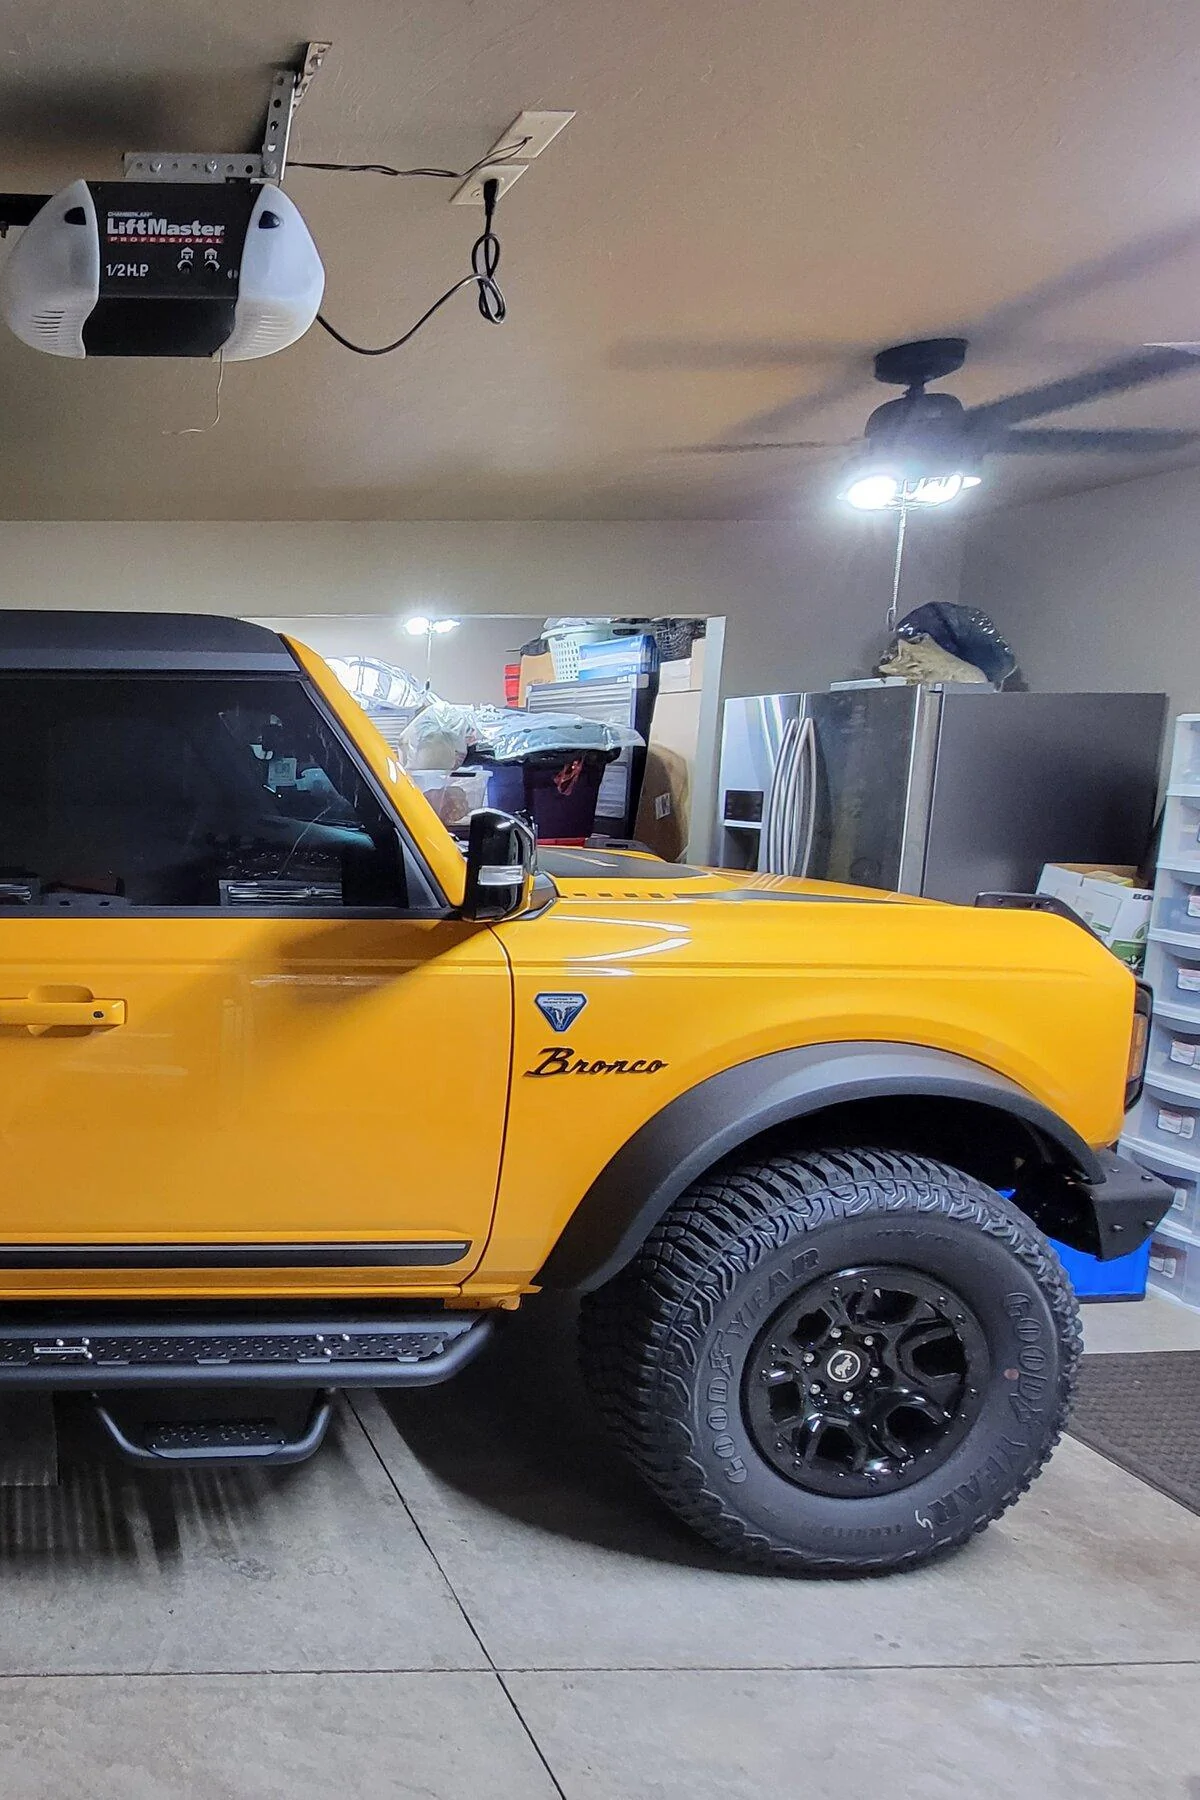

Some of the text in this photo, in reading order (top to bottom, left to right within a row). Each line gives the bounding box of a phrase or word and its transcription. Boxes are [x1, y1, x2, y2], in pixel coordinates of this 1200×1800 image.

[107, 218, 225, 236] LiftMaster
[110, 236, 222, 244] PROFESSIONAL
[523, 1047, 669, 1077] Bronco
